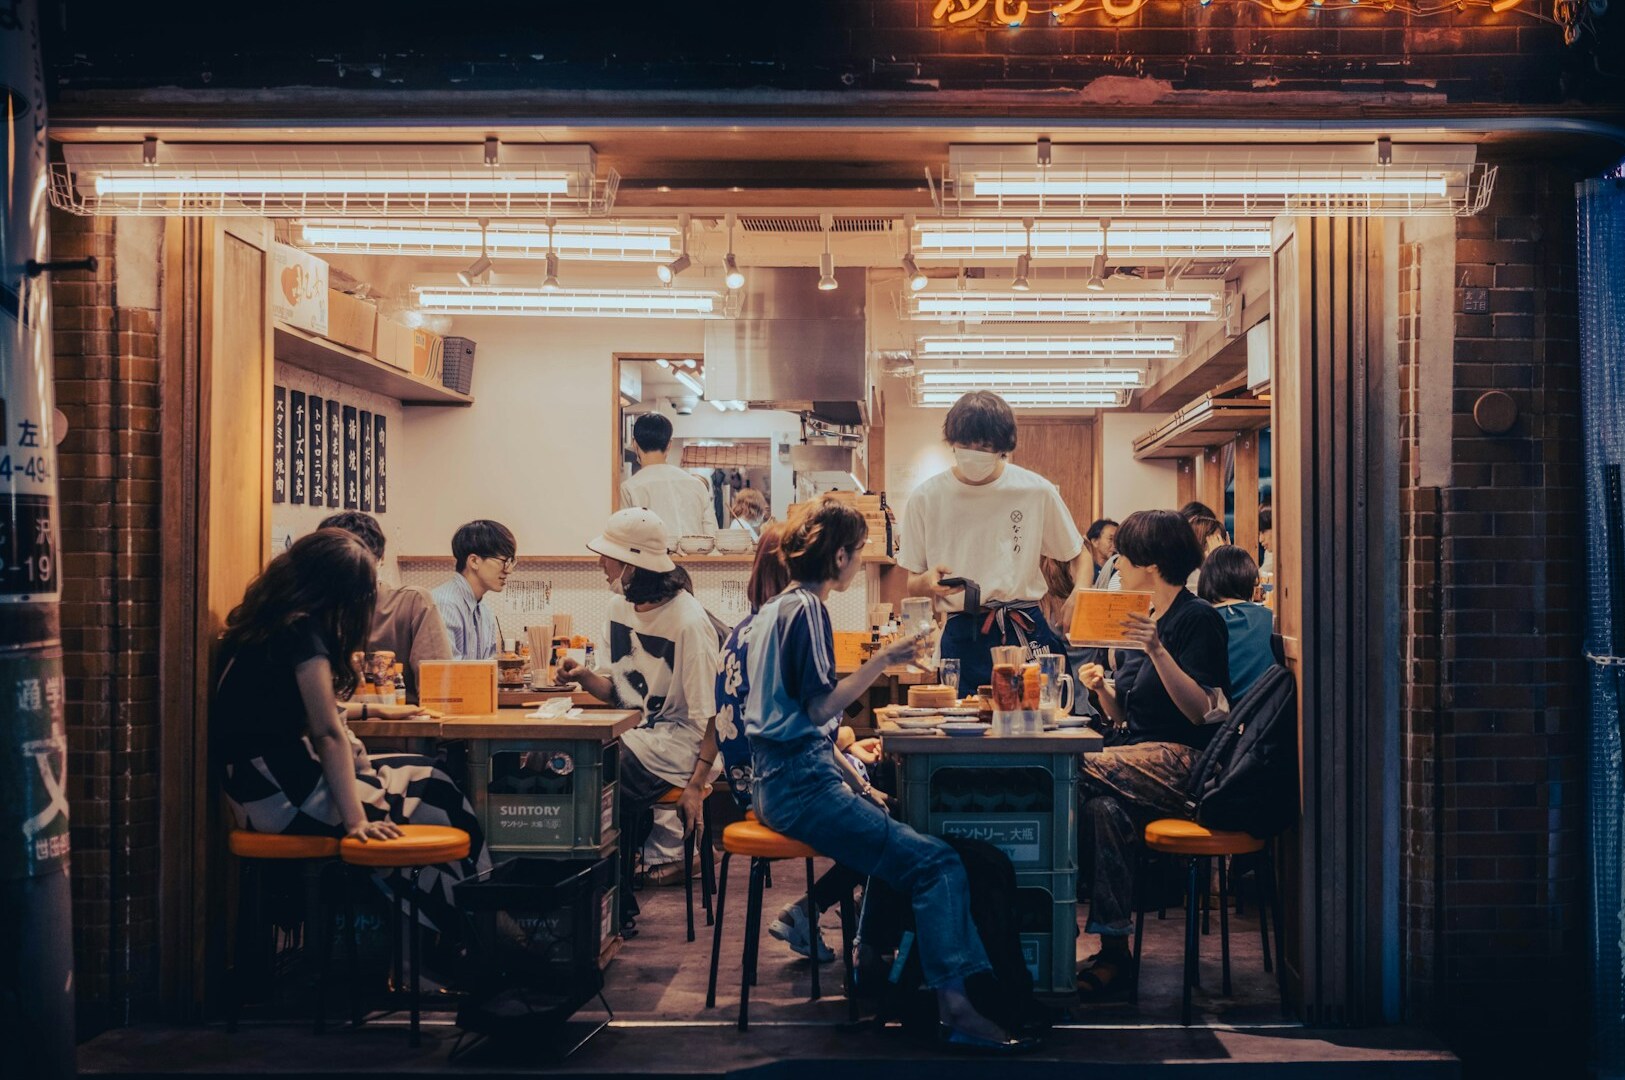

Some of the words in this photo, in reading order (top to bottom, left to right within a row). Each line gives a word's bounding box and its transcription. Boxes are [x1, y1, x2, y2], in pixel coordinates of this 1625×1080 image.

[1465, 301, 1486, 311] 二丁目
[275, 400, 285, 495] スタミナ焼肉
[295, 404, 305, 497] チーズ焼売
[314, 408, 323, 498] トロトロニラ玉
[500, 805, 561, 816] SUNTORY
[1009, 827, 1035, 841] 大瓶
